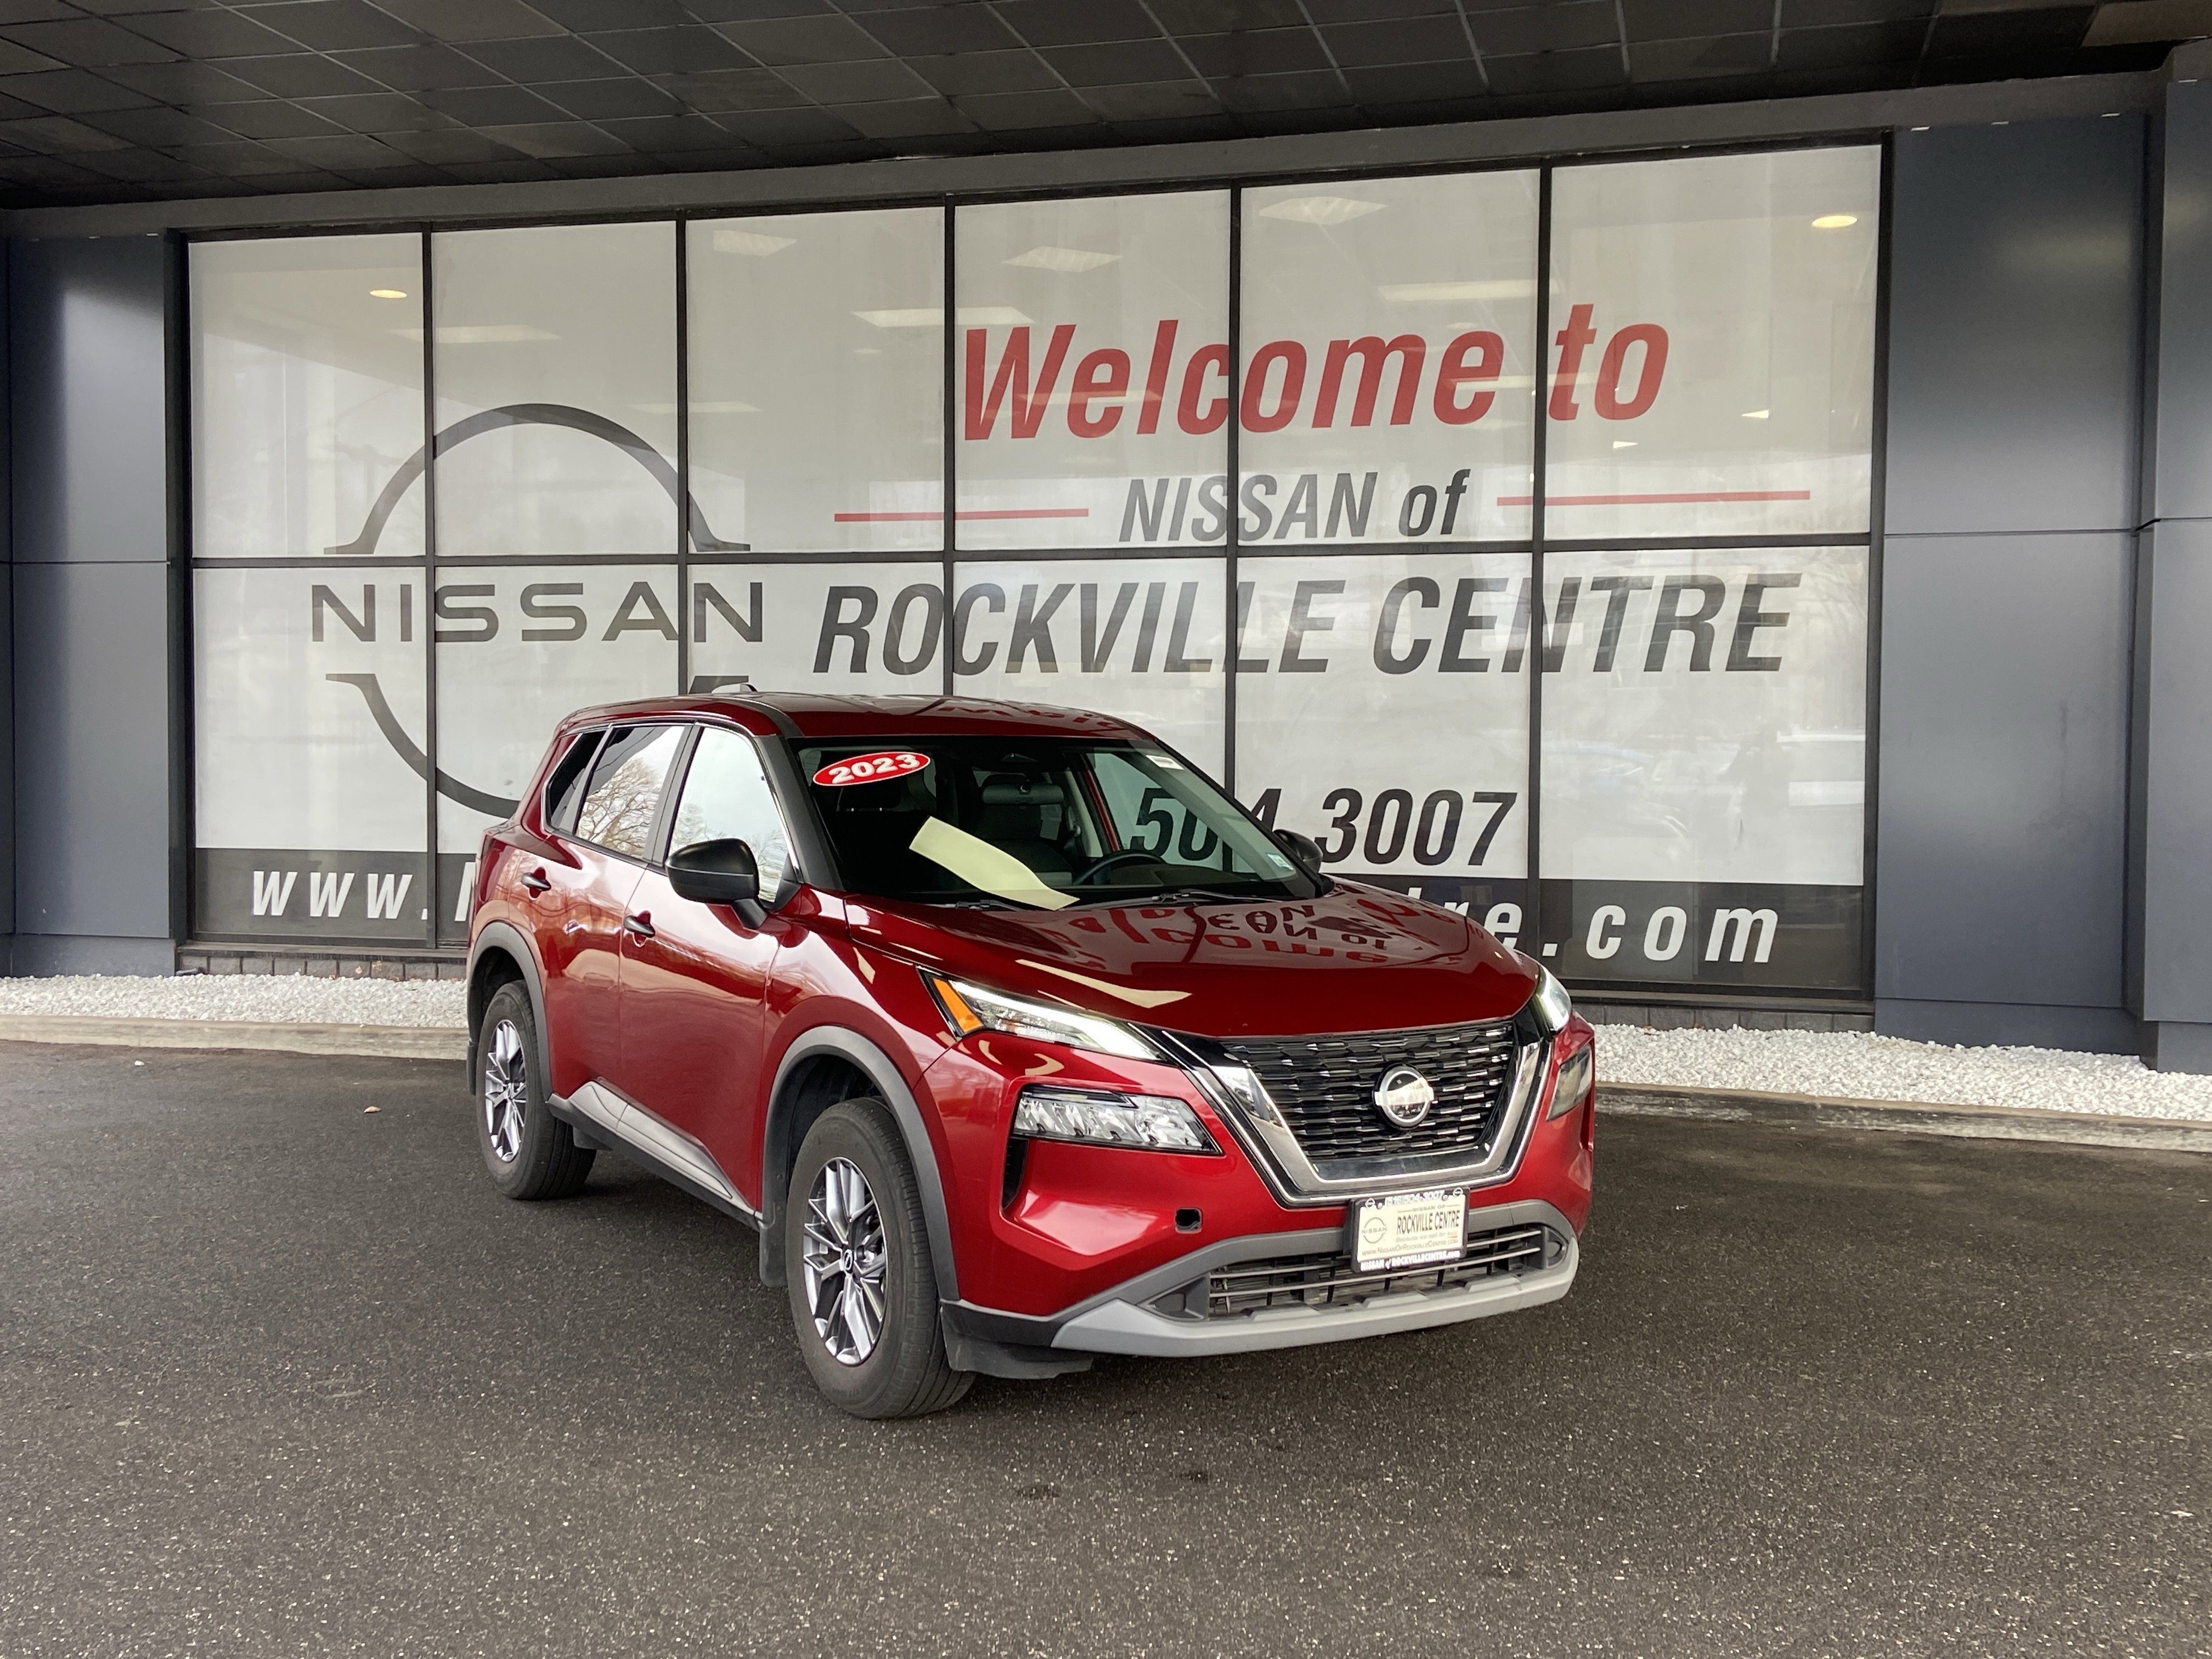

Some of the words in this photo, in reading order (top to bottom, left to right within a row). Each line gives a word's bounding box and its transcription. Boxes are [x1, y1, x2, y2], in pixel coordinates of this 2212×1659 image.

[964, 319, 1504, 441] Welcome
[1549, 304, 1669, 421] to
[1119, 472, 1378, 542] NISSAN
[1398, 469, 1471, 536] of
[312, 582, 763, 643] NISSAN
[812, 580, 1345, 676] ROCKVILLE
[1373, 573, 1802, 674] CENTRE
[828, 754, 920, 784] 2023
[1361, 1226, 1387, 1234] NISSAN
[1397, 1212, 1433, 1235] ROCKVILLE
[1434, 1210, 1460, 1230] CENTRE
